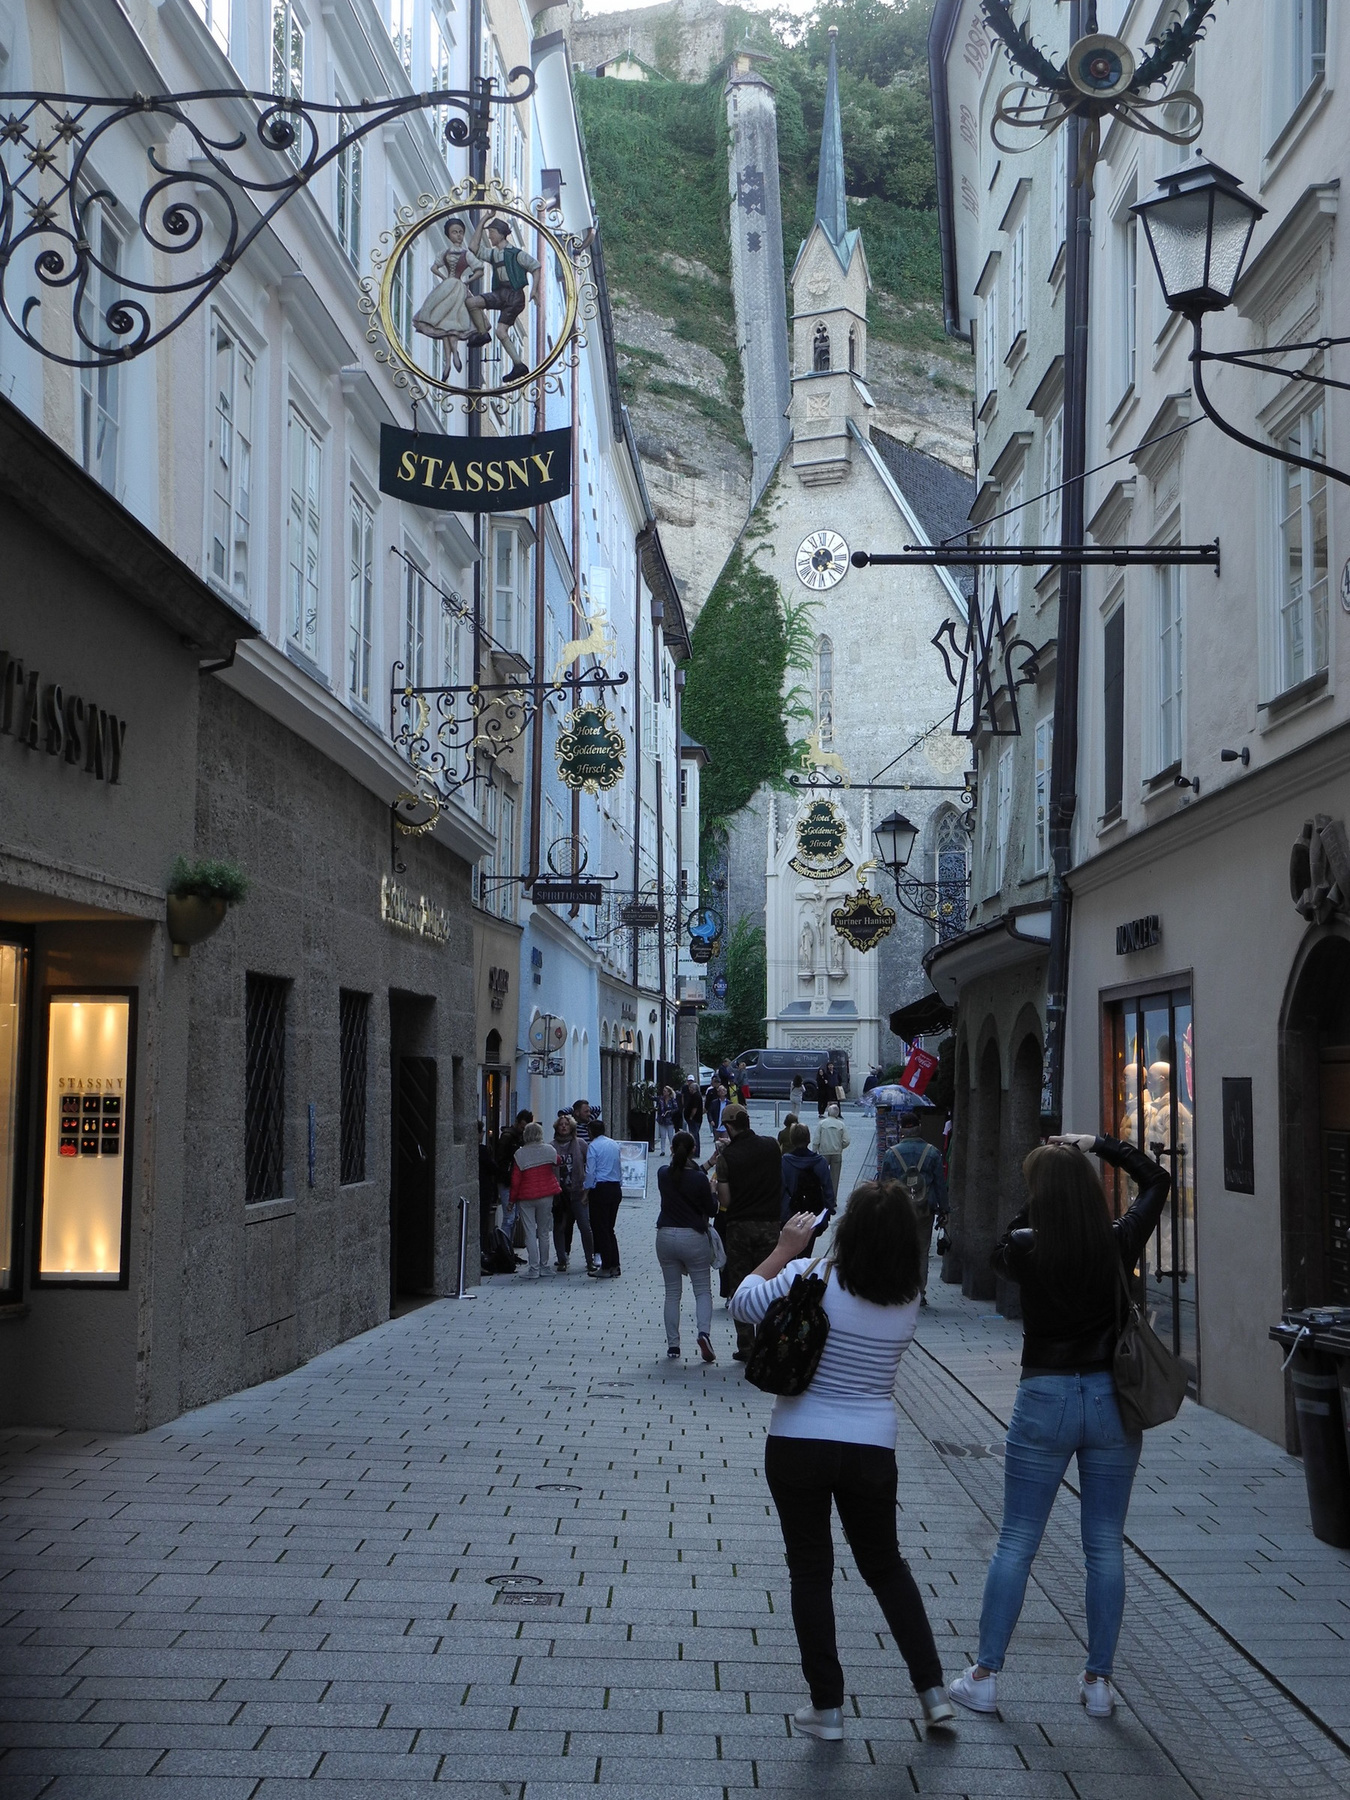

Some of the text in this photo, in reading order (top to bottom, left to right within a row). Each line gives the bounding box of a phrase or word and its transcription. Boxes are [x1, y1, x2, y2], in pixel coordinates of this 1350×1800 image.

[396, 450, 554, 492] STASSNY
[0, 649, 127, 786] TASSNY
[576, 725, 603, 737] Hotel
[572, 744, 612, 757] Goldener
[576, 762, 606, 775] Hirsch
[811, 813, 832, 822] Hotel
[807, 826, 837, 836] Goldener
[809, 839, 832, 848] Hirsch
[536, 890, 597, 900] SPIRITUOSEN
[864, 916, 893, 925] Hanisch
[1116, 915, 1159, 956] MONCLER
[58, 1077, 124, 1089] STASSNY
